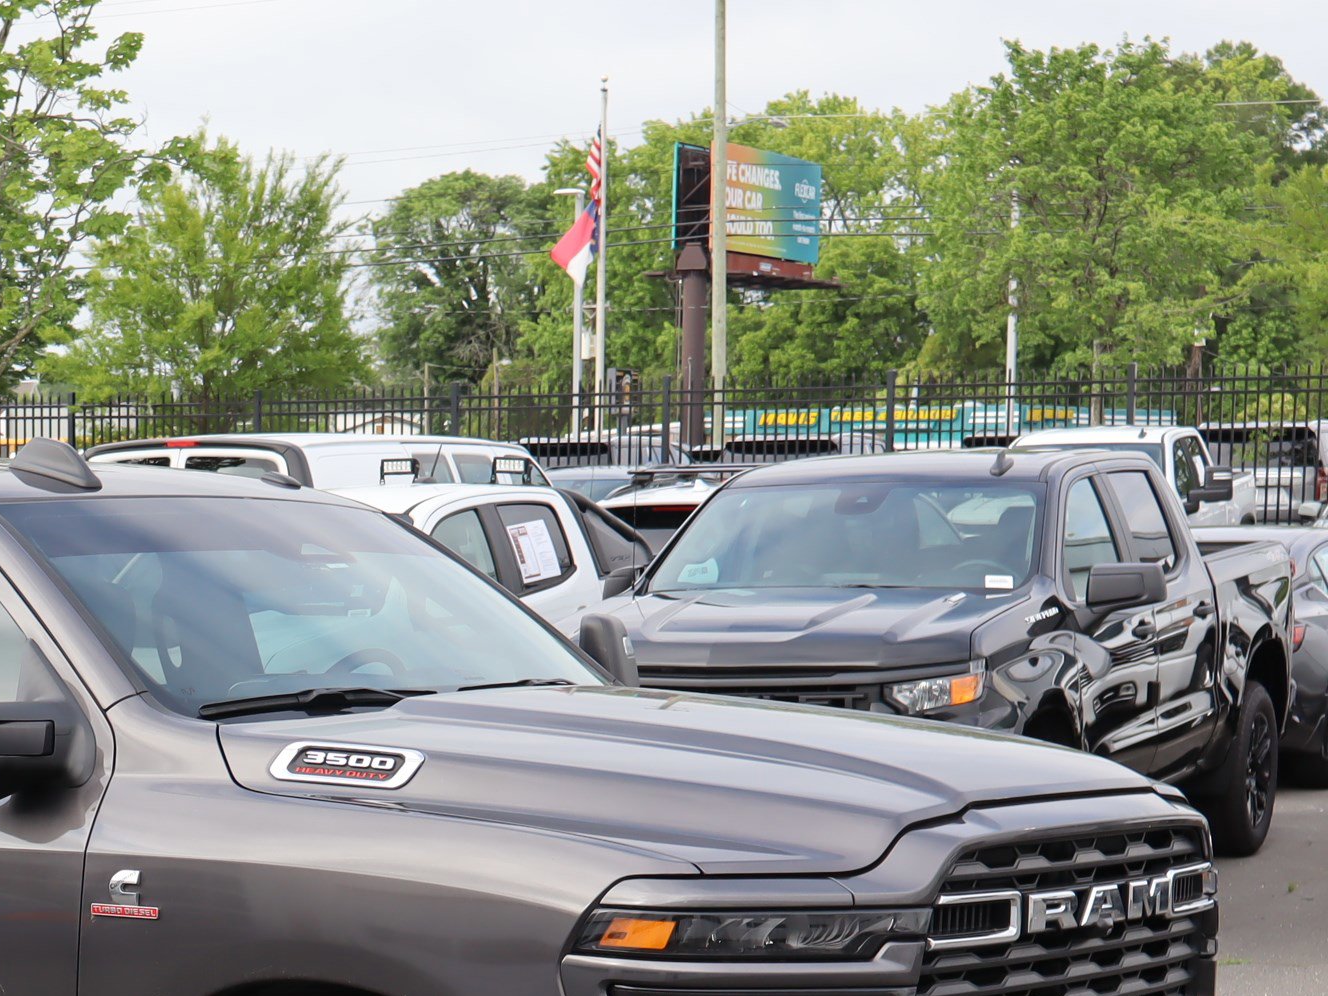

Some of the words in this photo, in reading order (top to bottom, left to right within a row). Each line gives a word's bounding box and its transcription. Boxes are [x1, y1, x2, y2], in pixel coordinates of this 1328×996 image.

[744, 190, 763, 212] CAR
[303, 750, 396, 770] 3500
[295, 766, 343, 776] HEAVY
[346, 770, 389, 780] DUTY
[92, 905, 123, 915] TURBO
[124, 907, 156, 917] DIESEL
[1027, 876, 1172, 934] RAM
